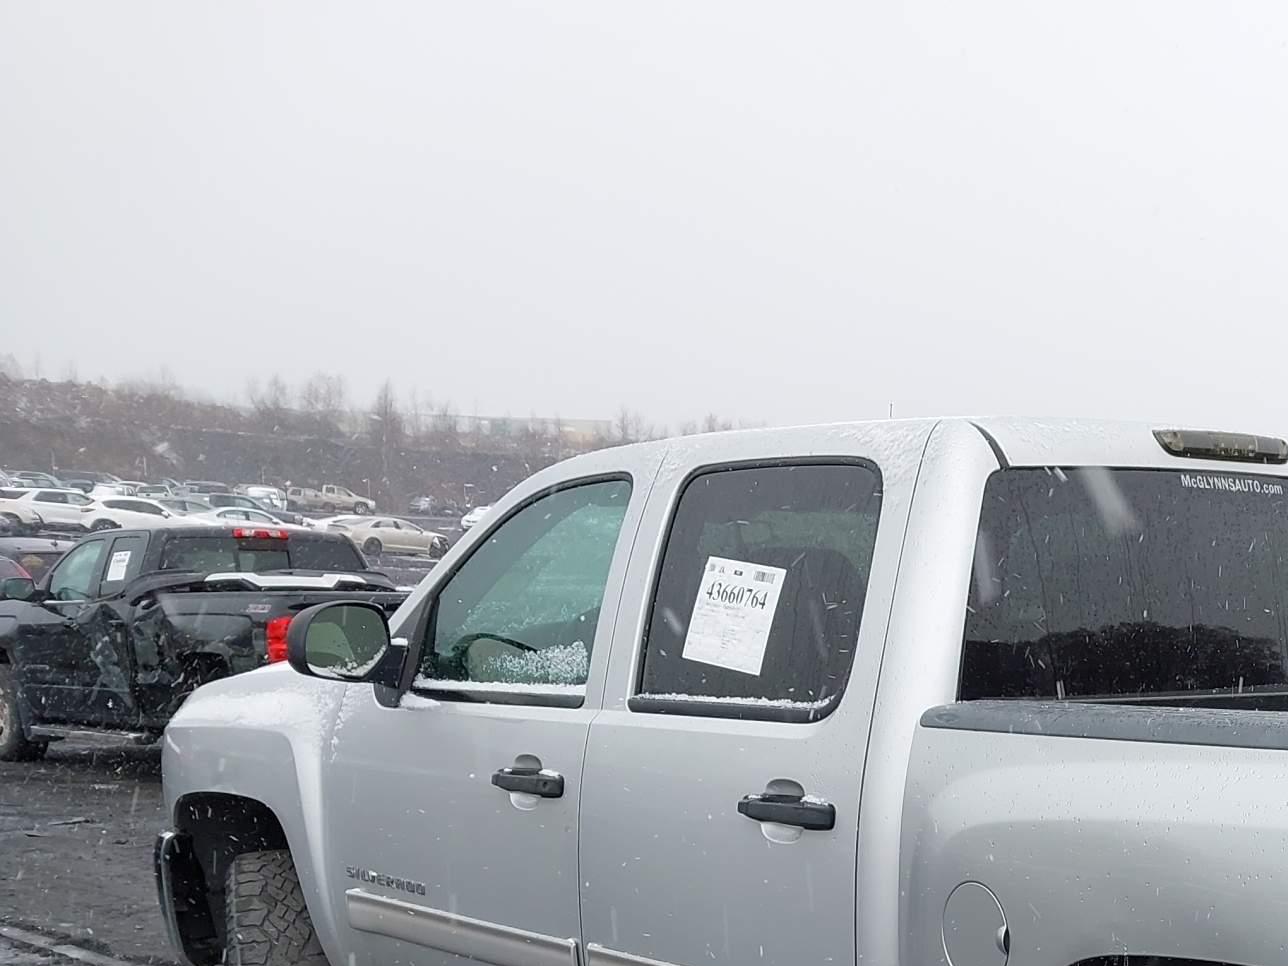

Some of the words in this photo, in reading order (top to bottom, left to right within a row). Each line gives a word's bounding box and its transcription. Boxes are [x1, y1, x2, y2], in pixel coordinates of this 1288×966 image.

[1181, 474, 1284, 496] McGLYNNSAUTO.com
[706, 581, 769, 610] 43660764
[345, 865, 426, 896] SILVERADO
